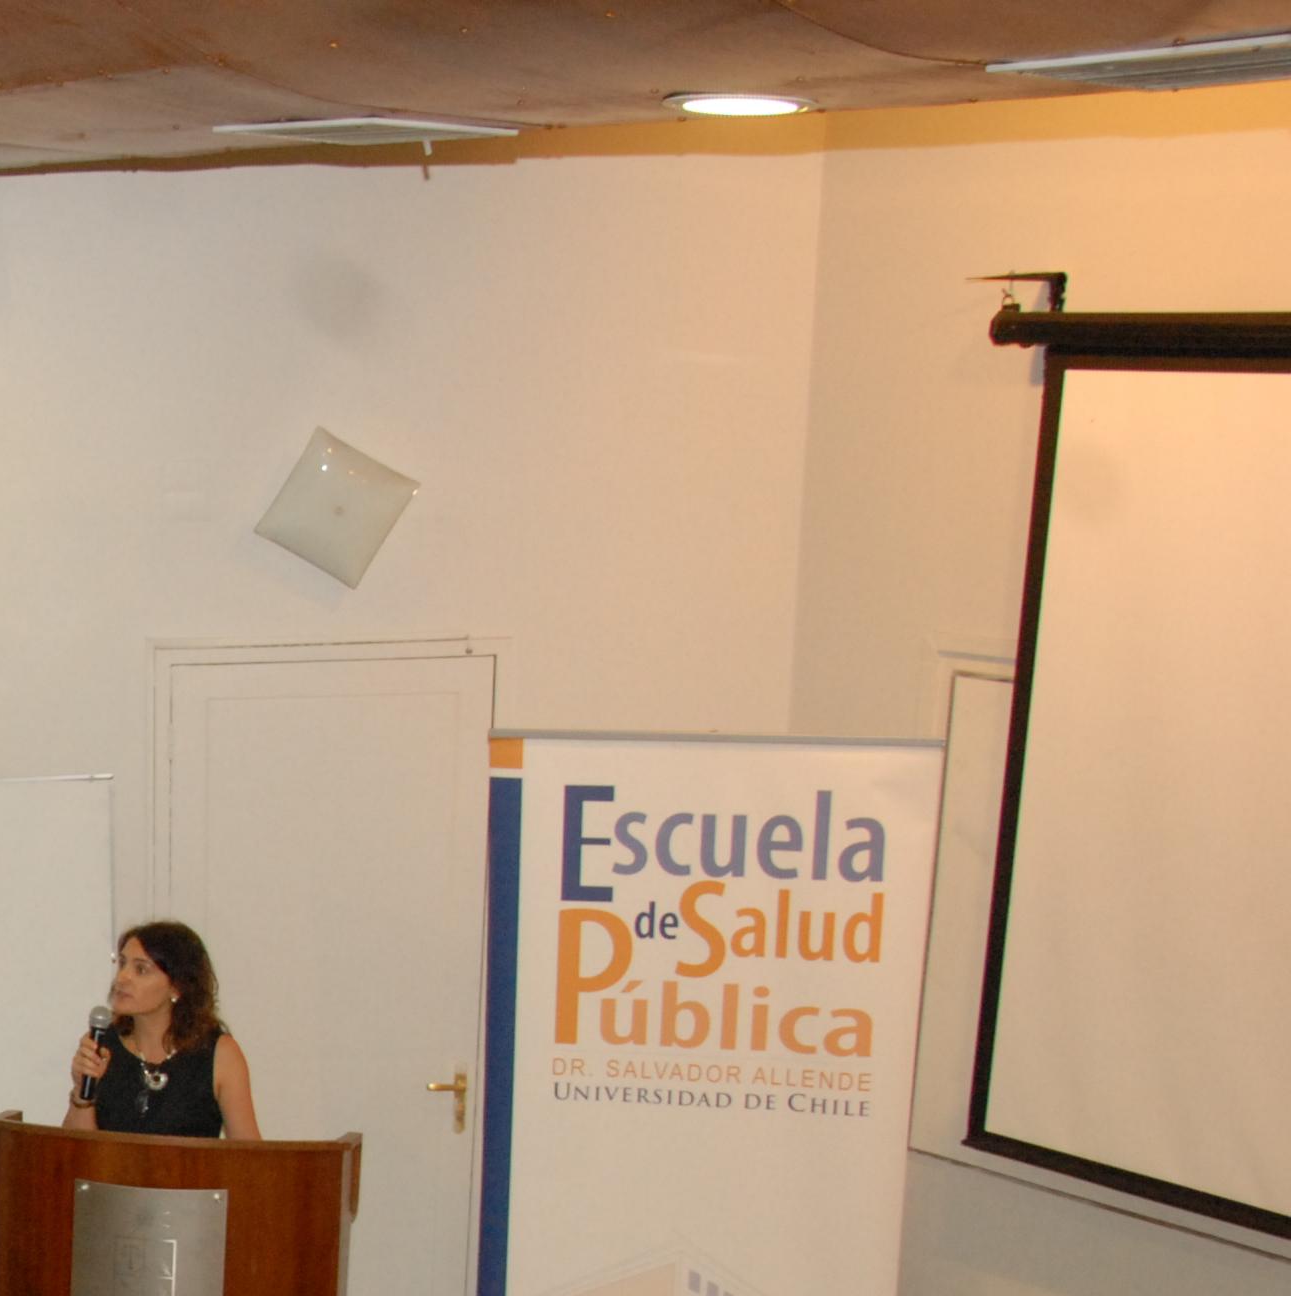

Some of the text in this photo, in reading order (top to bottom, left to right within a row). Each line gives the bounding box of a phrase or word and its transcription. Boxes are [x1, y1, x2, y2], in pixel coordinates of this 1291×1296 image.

[560, 784, 886, 902] Escuela
[634, 880, 884, 978] de Salud
[554, 908, 873, 1058] Pública
[552, 1057, 872, 1092] DR. SALVADOR ALLENDE
[553, 1082, 871, 1118] UNIVERSIDAD DE CHILE
